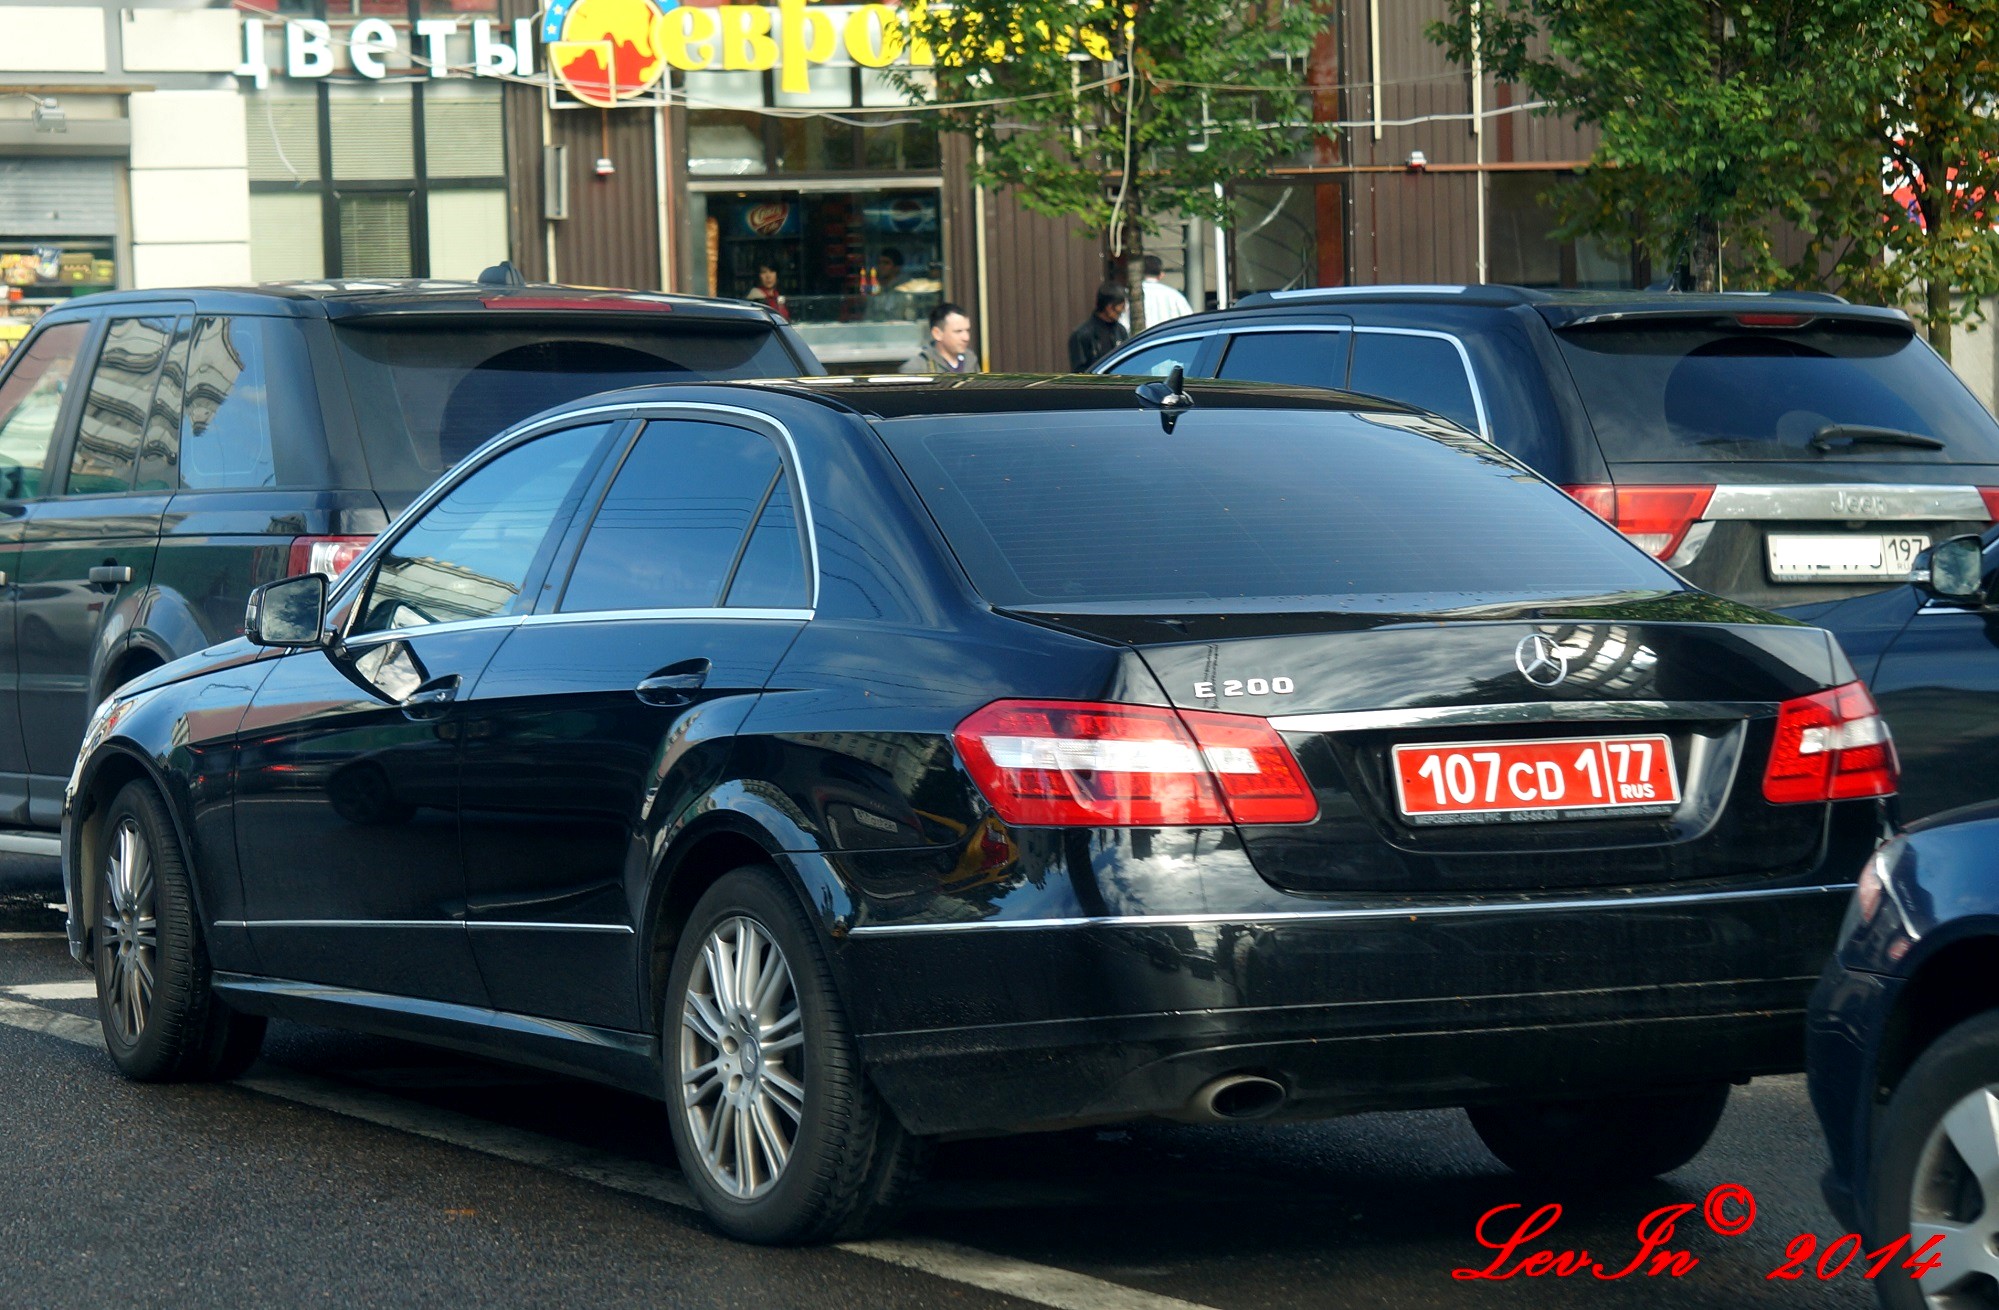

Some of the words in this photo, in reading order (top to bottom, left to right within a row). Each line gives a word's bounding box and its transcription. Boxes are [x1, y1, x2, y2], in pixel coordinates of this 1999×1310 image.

[1831, 491, 1887, 516] Jeep
[1888, 538, 1923, 561] 197
[1194, 681, 1217, 698] E
[1223, 677, 1294, 697] 200
[1608, 743, 1652, 783] 77
[1619, 783, 1656, 799] RUS
